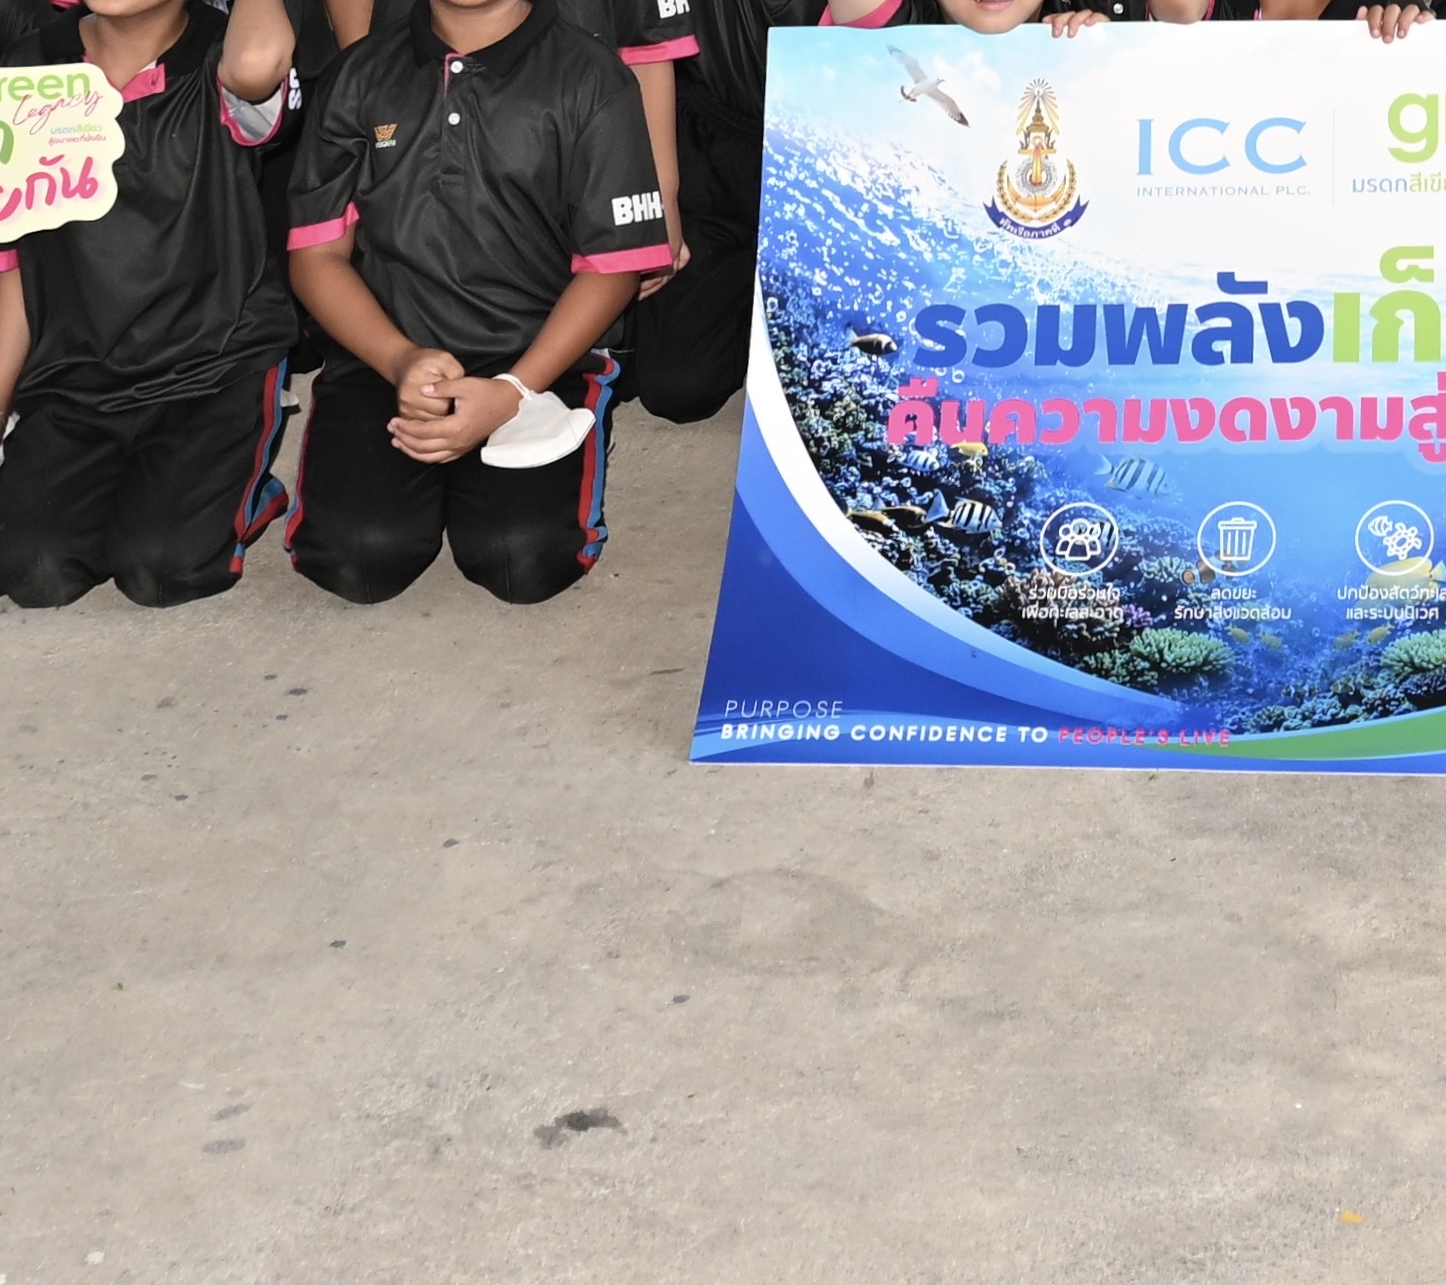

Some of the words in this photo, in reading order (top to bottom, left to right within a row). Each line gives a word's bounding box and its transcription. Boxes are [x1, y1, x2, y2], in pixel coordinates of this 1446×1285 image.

[1135, 116, 1308, 176] ICC
[1136, 186, 1270, 198] INTERNATIONAL
[1275, 184, 1312, 196] PLC.
[1210, 586, 1257, 601] ลดขยะ
[1173, 603, 1292, 621] รักษาสิ่งแวดล้อม
[1345, 606, 1440, 621] และระบบนิเวศ
[724, 699, 844, 719] PURPOSE
[720, 724, 842, 741] BRINGING
[850, 725, 1008, 743] CONFIDENCE
[1018, 726, 1049, 744] TO
